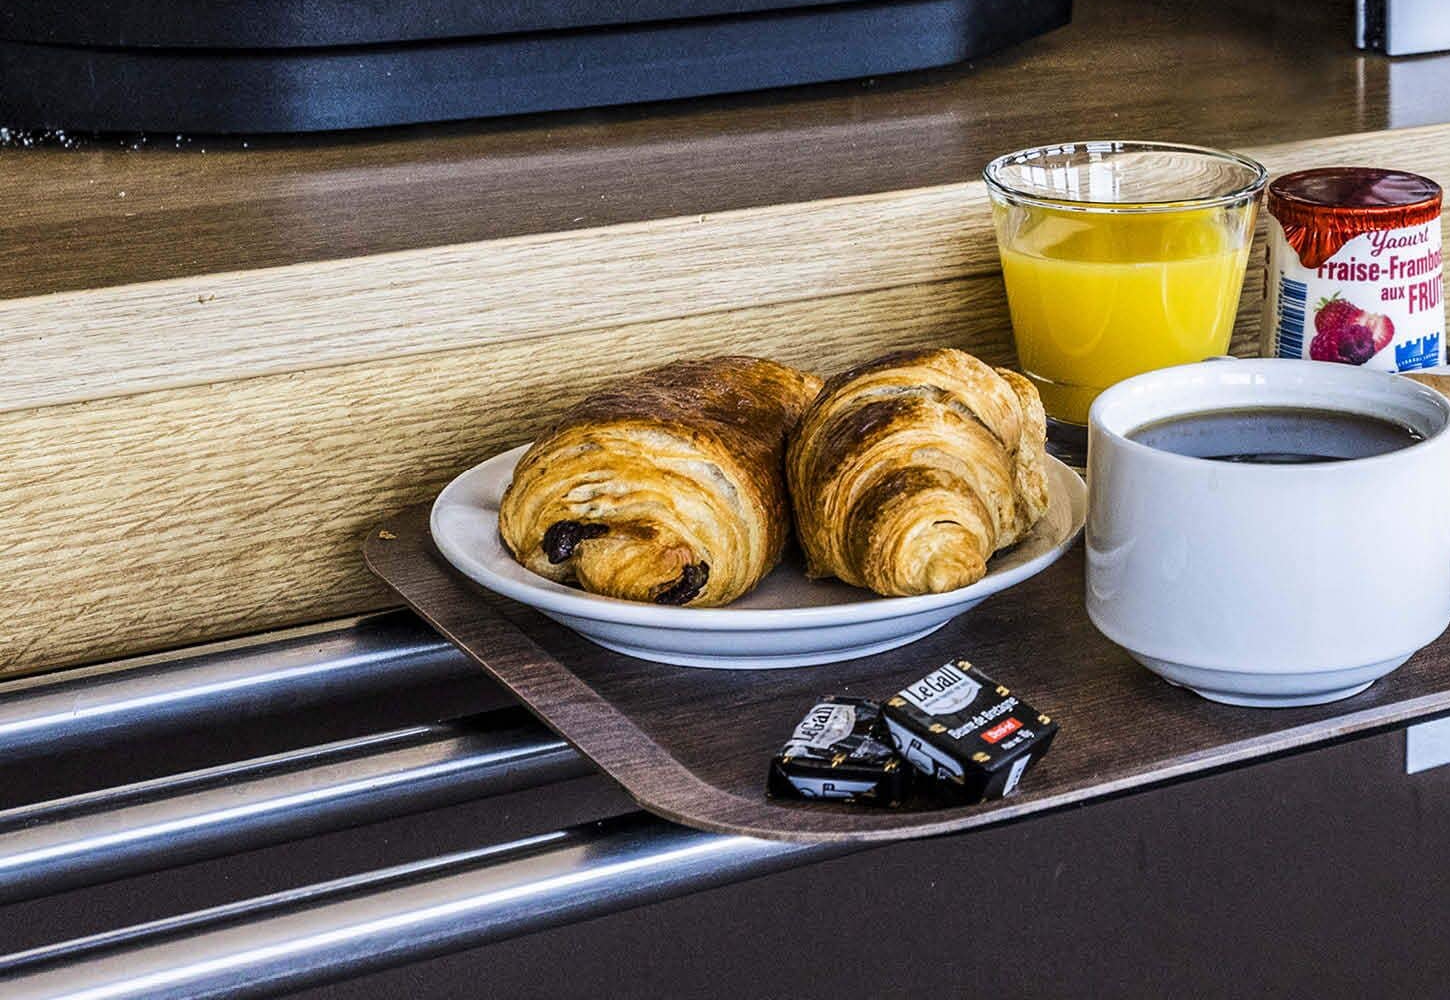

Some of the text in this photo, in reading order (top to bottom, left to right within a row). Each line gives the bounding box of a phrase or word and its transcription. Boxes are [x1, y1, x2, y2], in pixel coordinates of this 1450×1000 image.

[1366, 226, 1430, 257] Yaourt
[1381, 286, 1405, 301] aux
[923, 666, 963, 693] Gall
